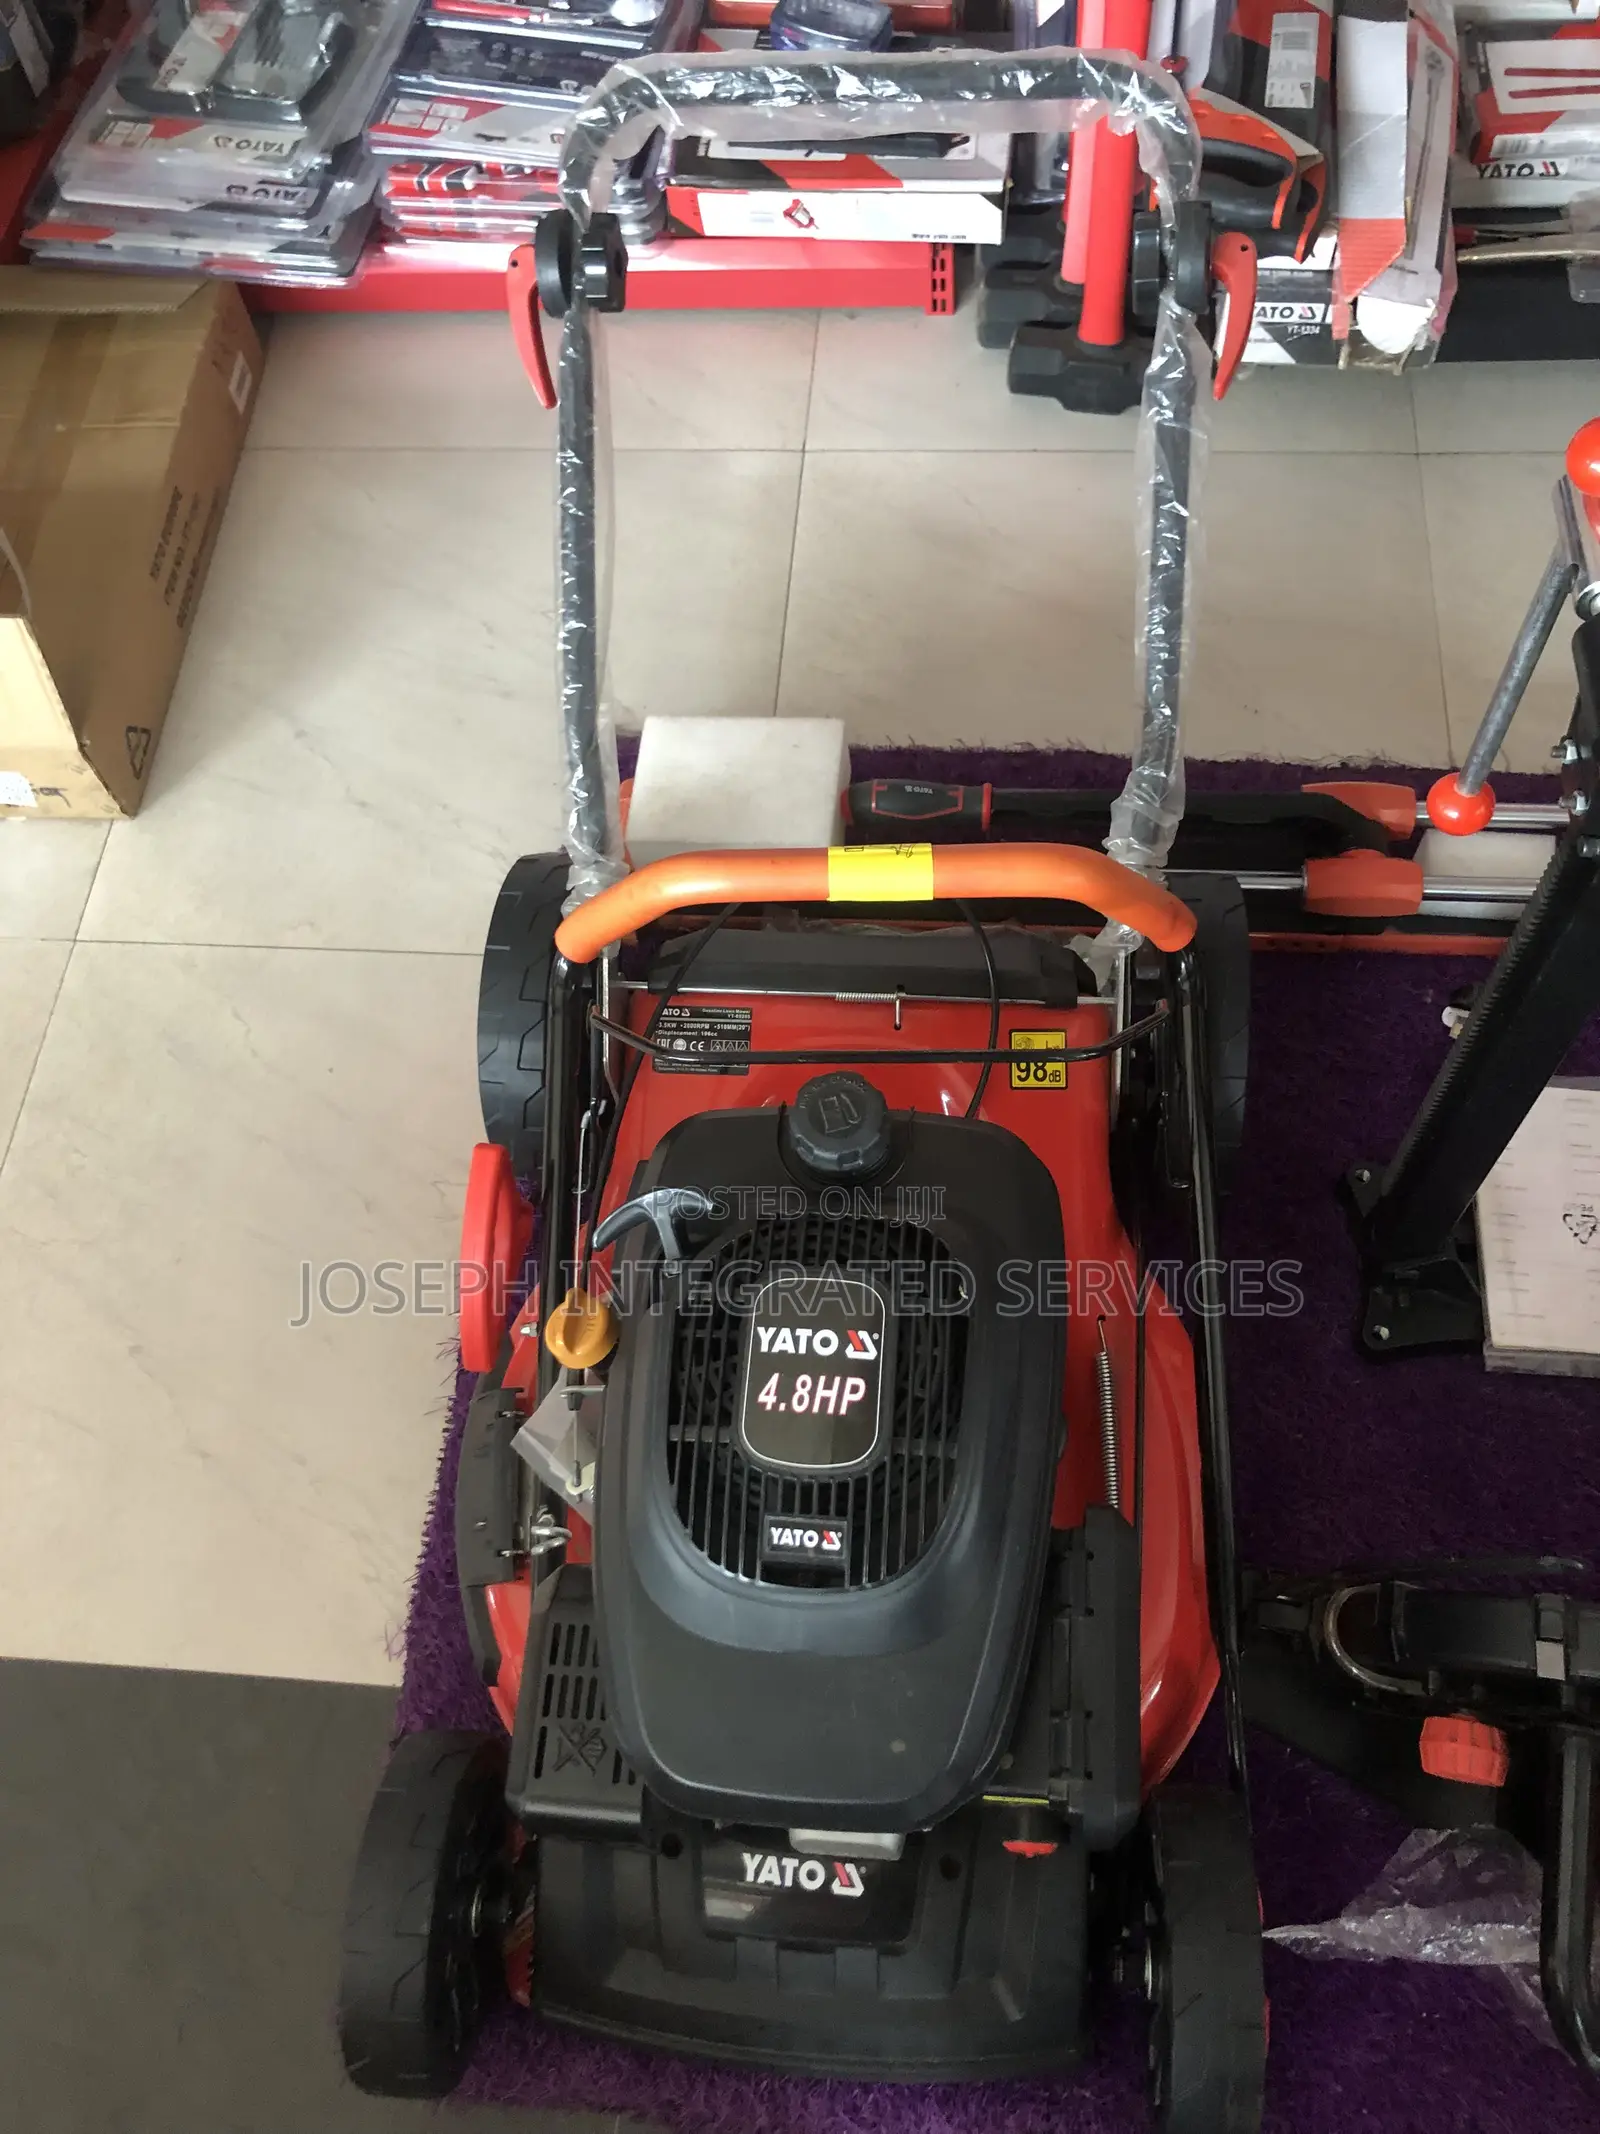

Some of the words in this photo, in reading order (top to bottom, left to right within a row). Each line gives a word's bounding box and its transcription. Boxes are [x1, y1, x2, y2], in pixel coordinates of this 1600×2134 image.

[1477, 162, 1534, 178] YATO
[1255, 306, 1294, 319] ATO
[662, 1008, 680, 1016] ATO
[1015, 1061, 1048, 1083] 98
[757, 1326, 839, 1356] YATO
[757, 1372, 866, 1416] 4.8HP
[770, 1526, 819, 1548] YATO
[742, 1852, 825, 1890] YATO
